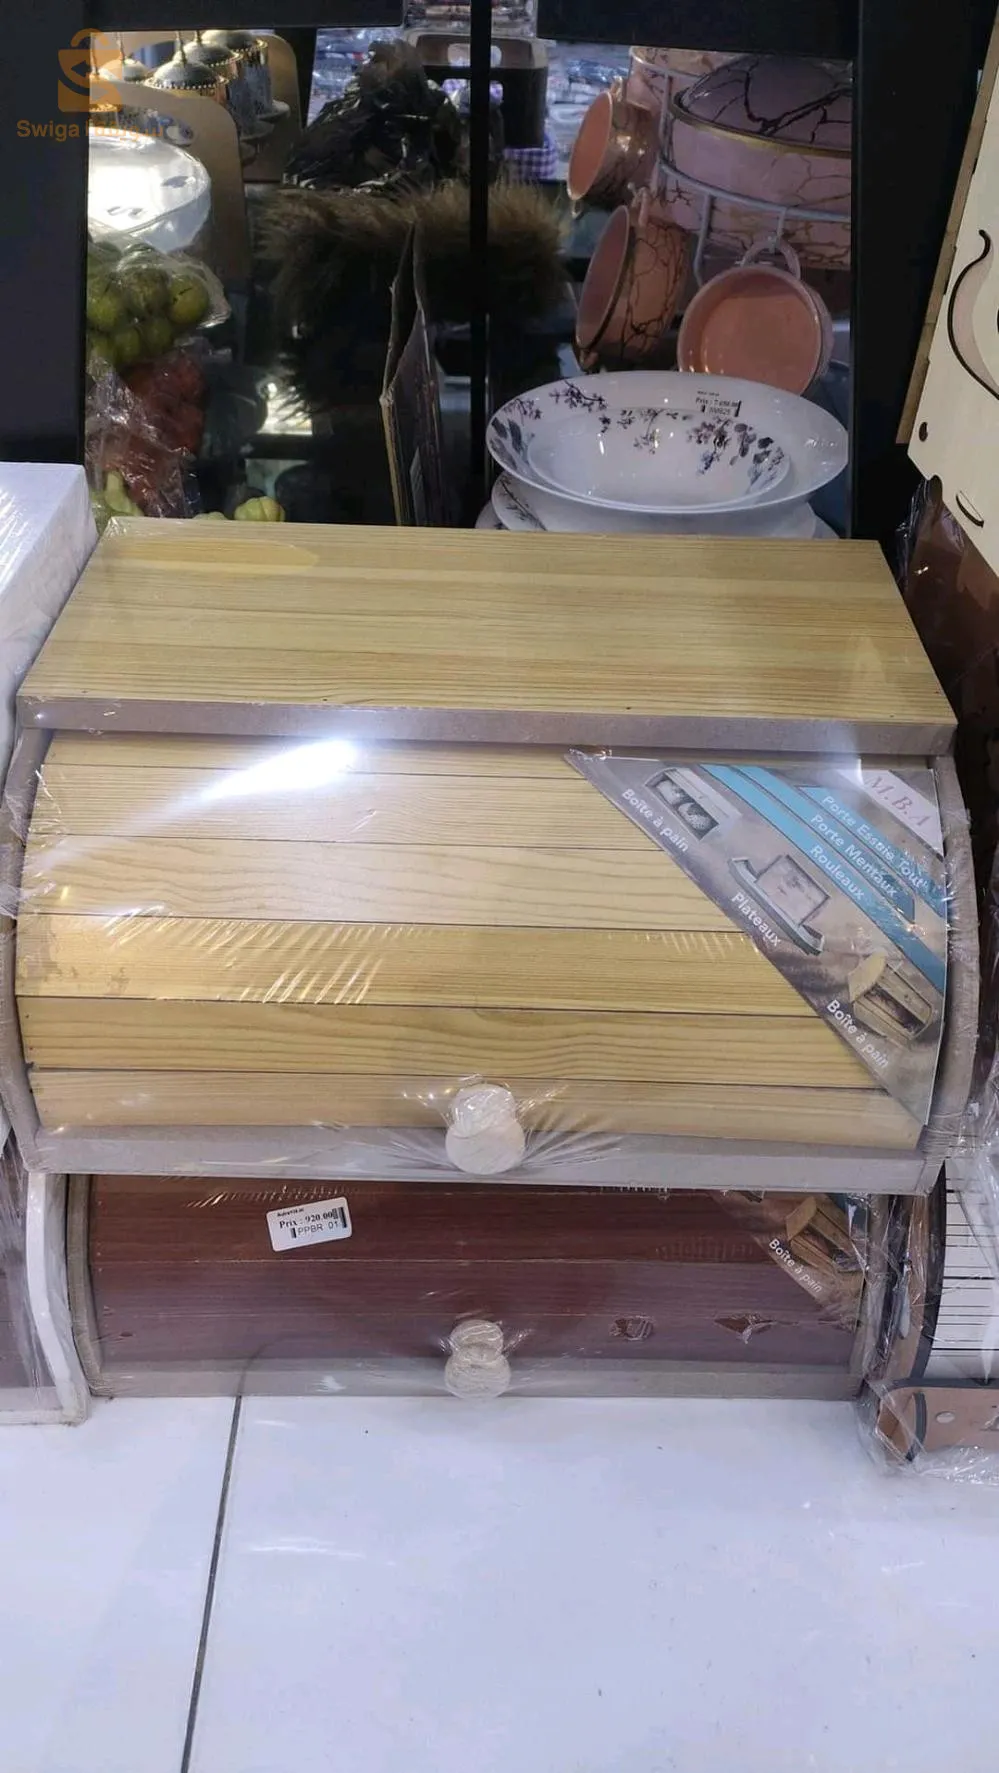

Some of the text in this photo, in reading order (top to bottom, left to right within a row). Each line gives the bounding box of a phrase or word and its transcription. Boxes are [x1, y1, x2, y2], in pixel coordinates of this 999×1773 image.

[823, 795, 857, 826] Porte
[652, 816, 665, 829] à
[659, 827, 689, 852] pain
[810, 814, 845, 847] Porte
[809, 844, 865, 901] Rouleaux
[731, 891, 782, 947] Plateaux
[826, 999, 889, 1069] Boîte à pain
[279, 1220, 298, 1229] Prix
[298, 1223, 324, 1235] PPBR
[768, 1238, 796, 1267] Boîte
[799, 1274, 822, 1292] pain
